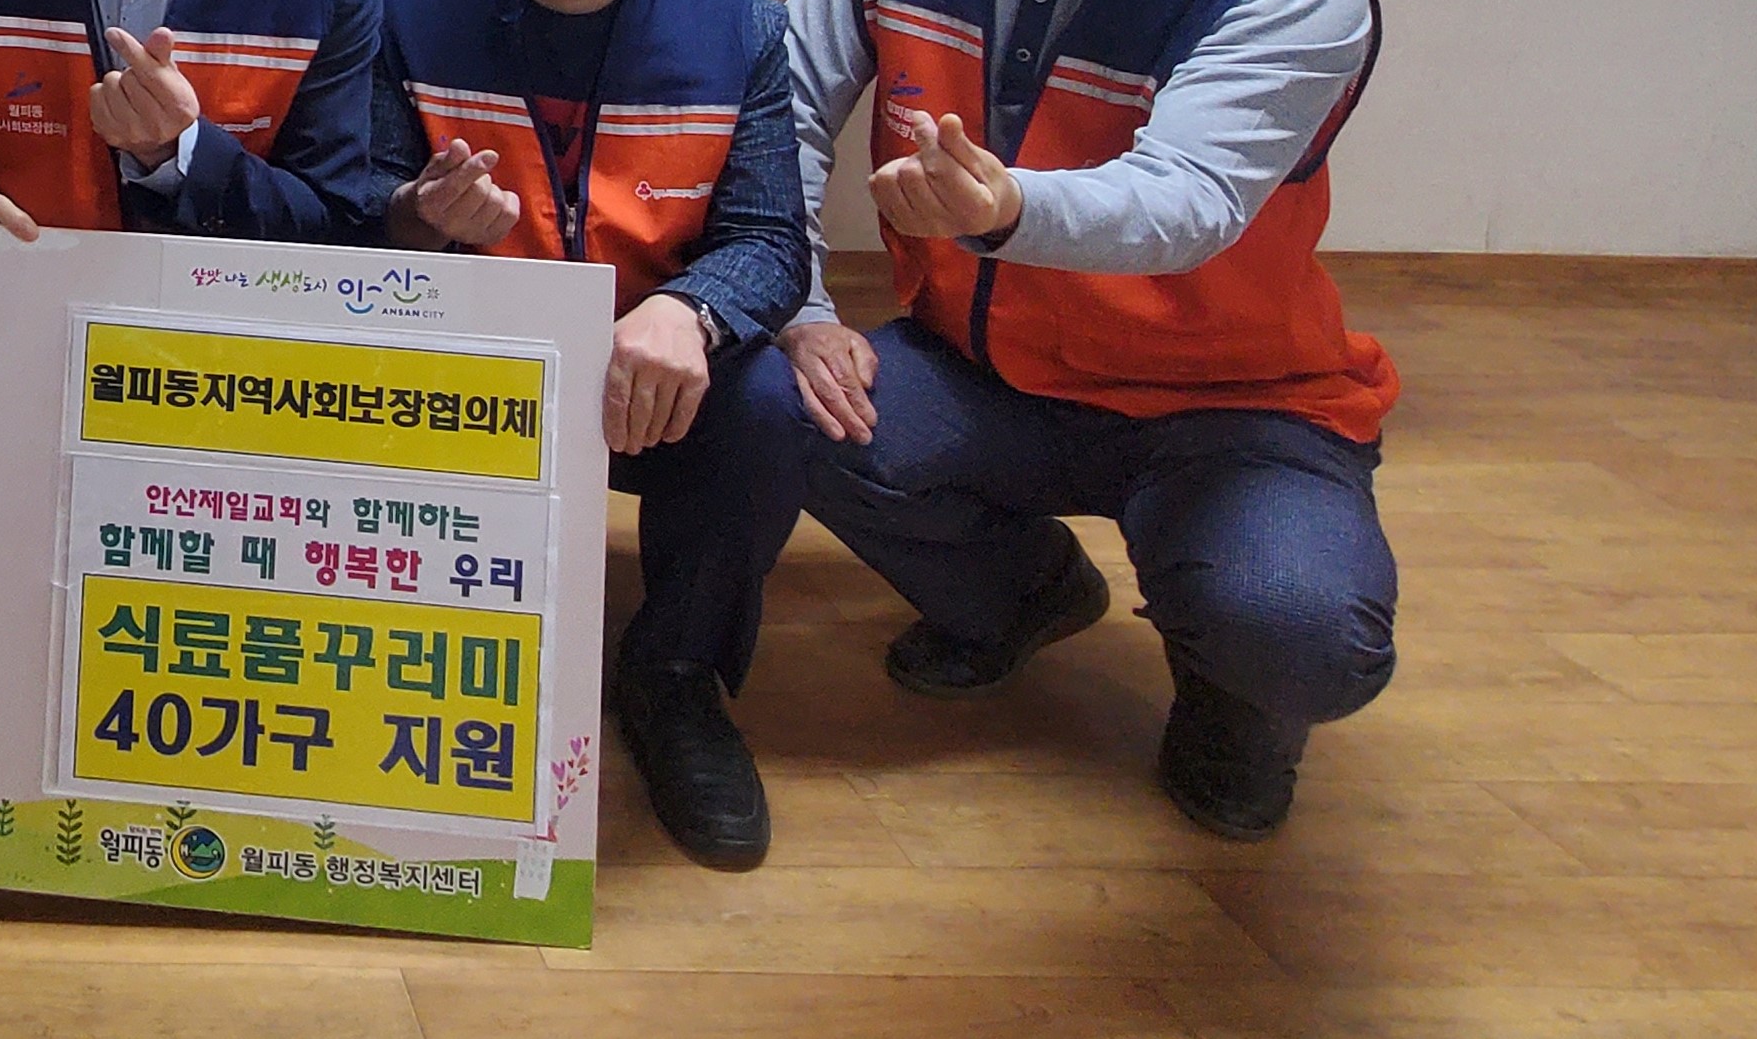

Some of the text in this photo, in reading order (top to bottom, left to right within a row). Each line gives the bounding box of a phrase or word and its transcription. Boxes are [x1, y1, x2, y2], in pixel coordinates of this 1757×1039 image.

[381, 307, 445, 319] ANSAN CITY
[90, 363, 538, 438] 월피동지역사회보장협의체
[145, 484, 480, 543] 안산제일교회와 함께하는
[99, 523, 524, 602] 함께할 때 행복한 우리
[97, 604, 521, 706] 식료품꾸러미
[93, 689, 515, 791] 40가구 지원
[100, 828, 164, 869] 월피동
[240, 846, 482, 895] 월피동 행정복지센터
